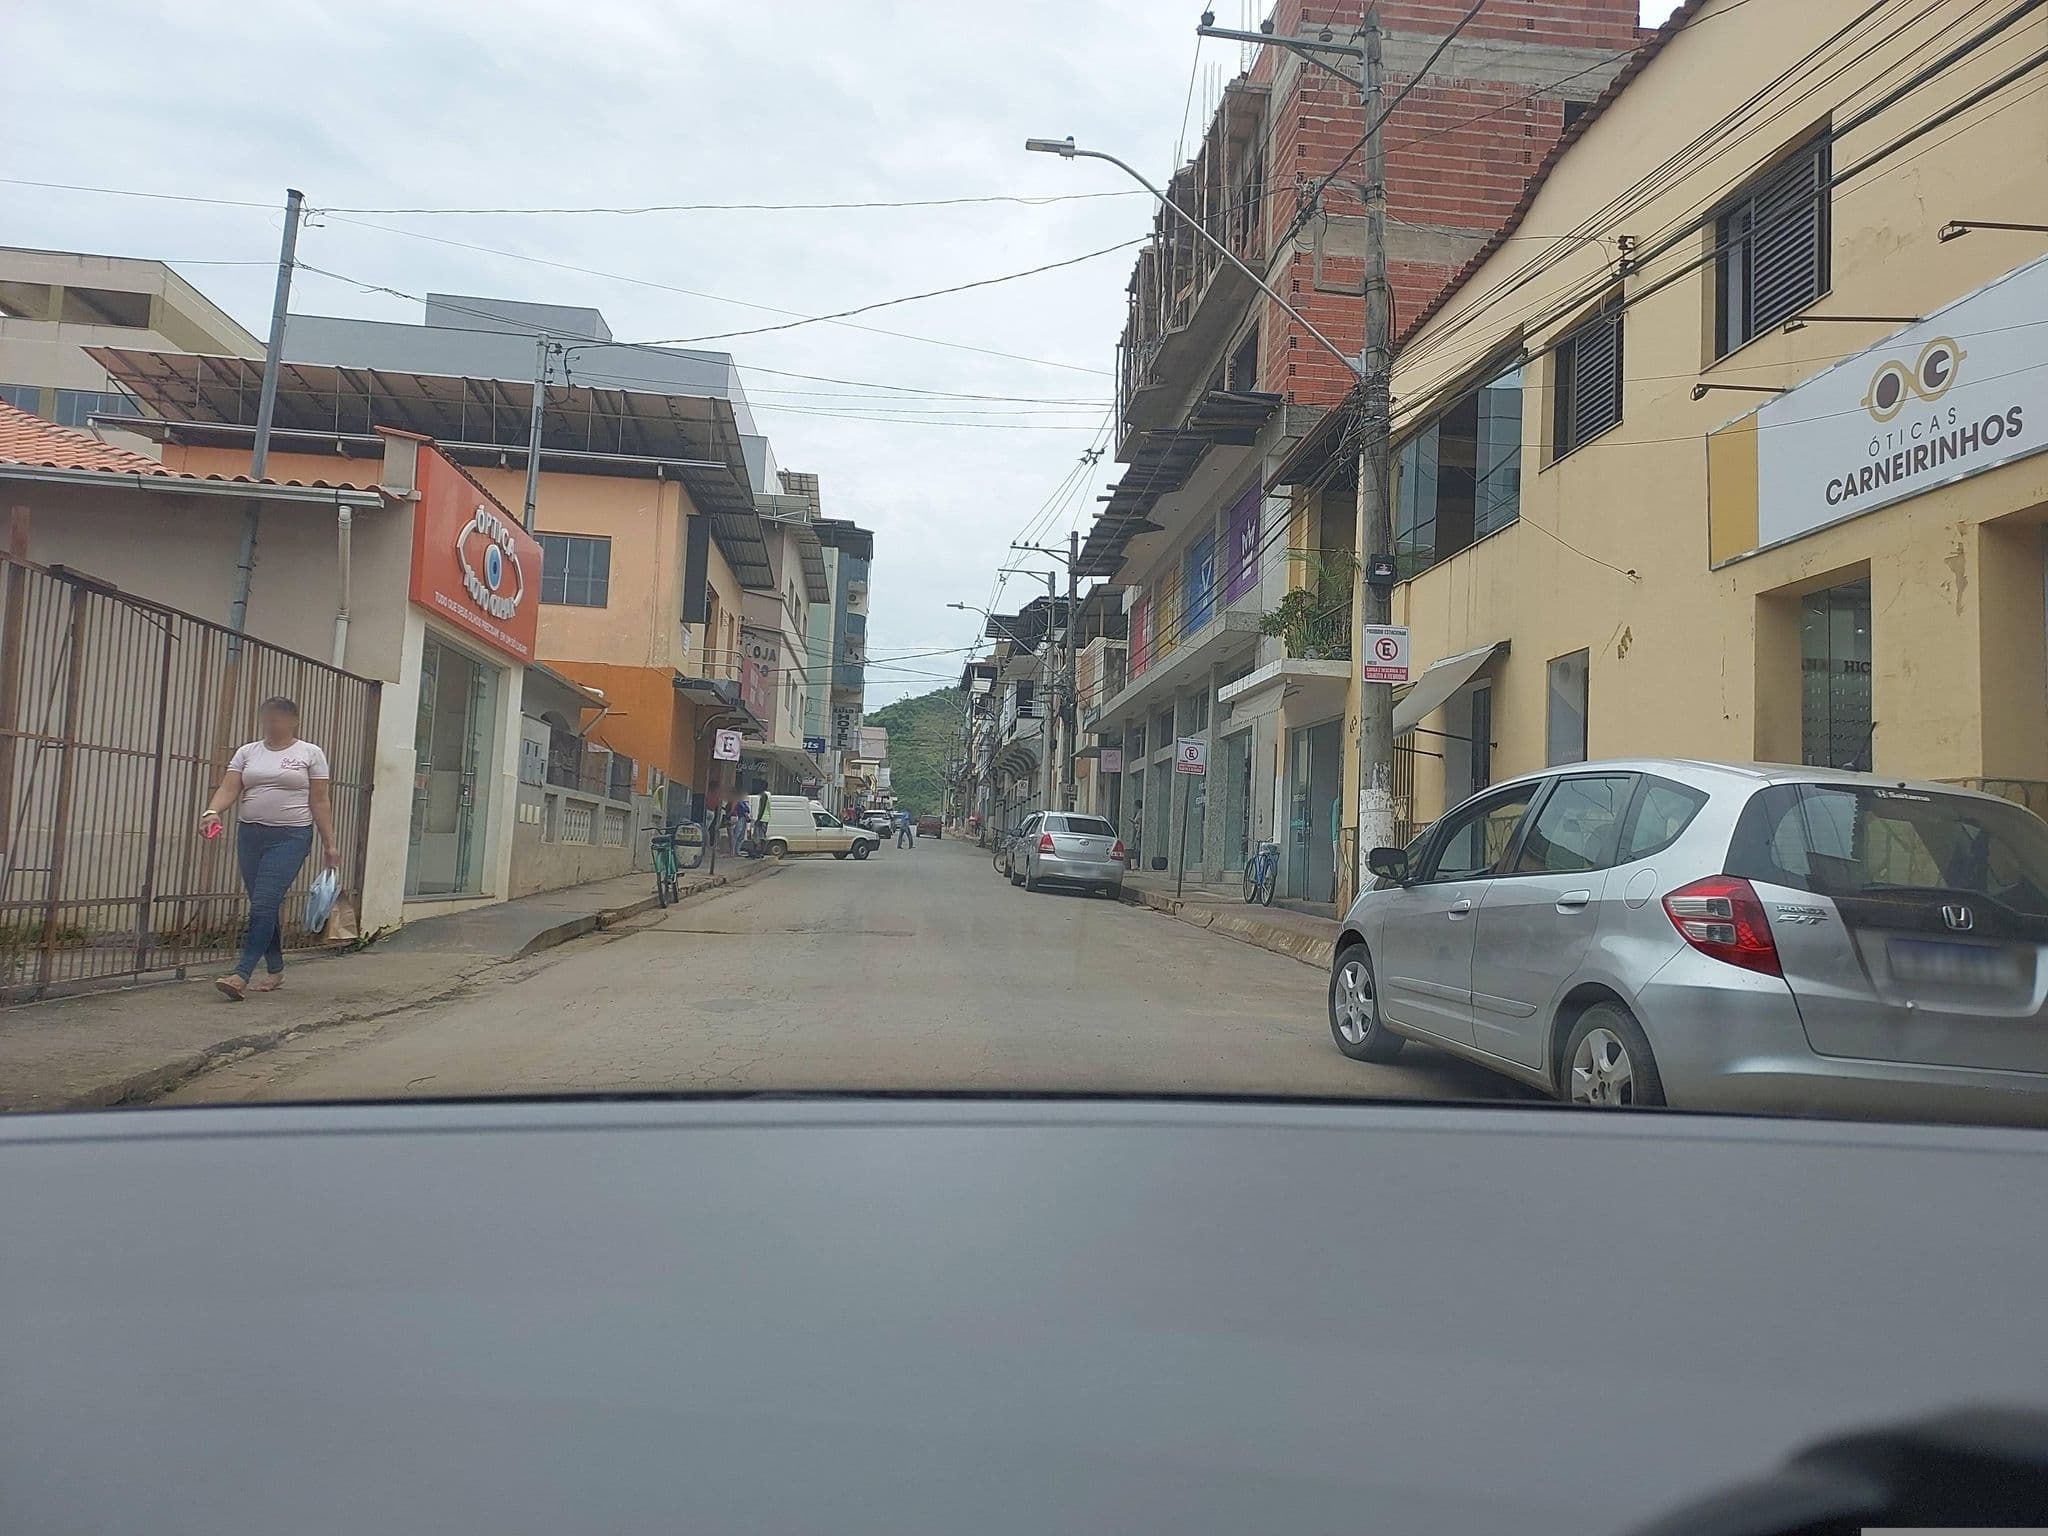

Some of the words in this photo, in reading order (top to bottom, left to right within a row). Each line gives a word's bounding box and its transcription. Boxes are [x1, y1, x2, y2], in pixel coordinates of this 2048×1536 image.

[1868, 406, 1957, 457] ÓTICAS
[1825, 405, 2023, 506] CARNEIRINHOS
[475, 504, 515, 561] ÓPTICA
[837, 713, 850, 747] HOTEL
[1776, 904, 1828, 916] HONDA
[1777, 914, 1830, 925] FIT
